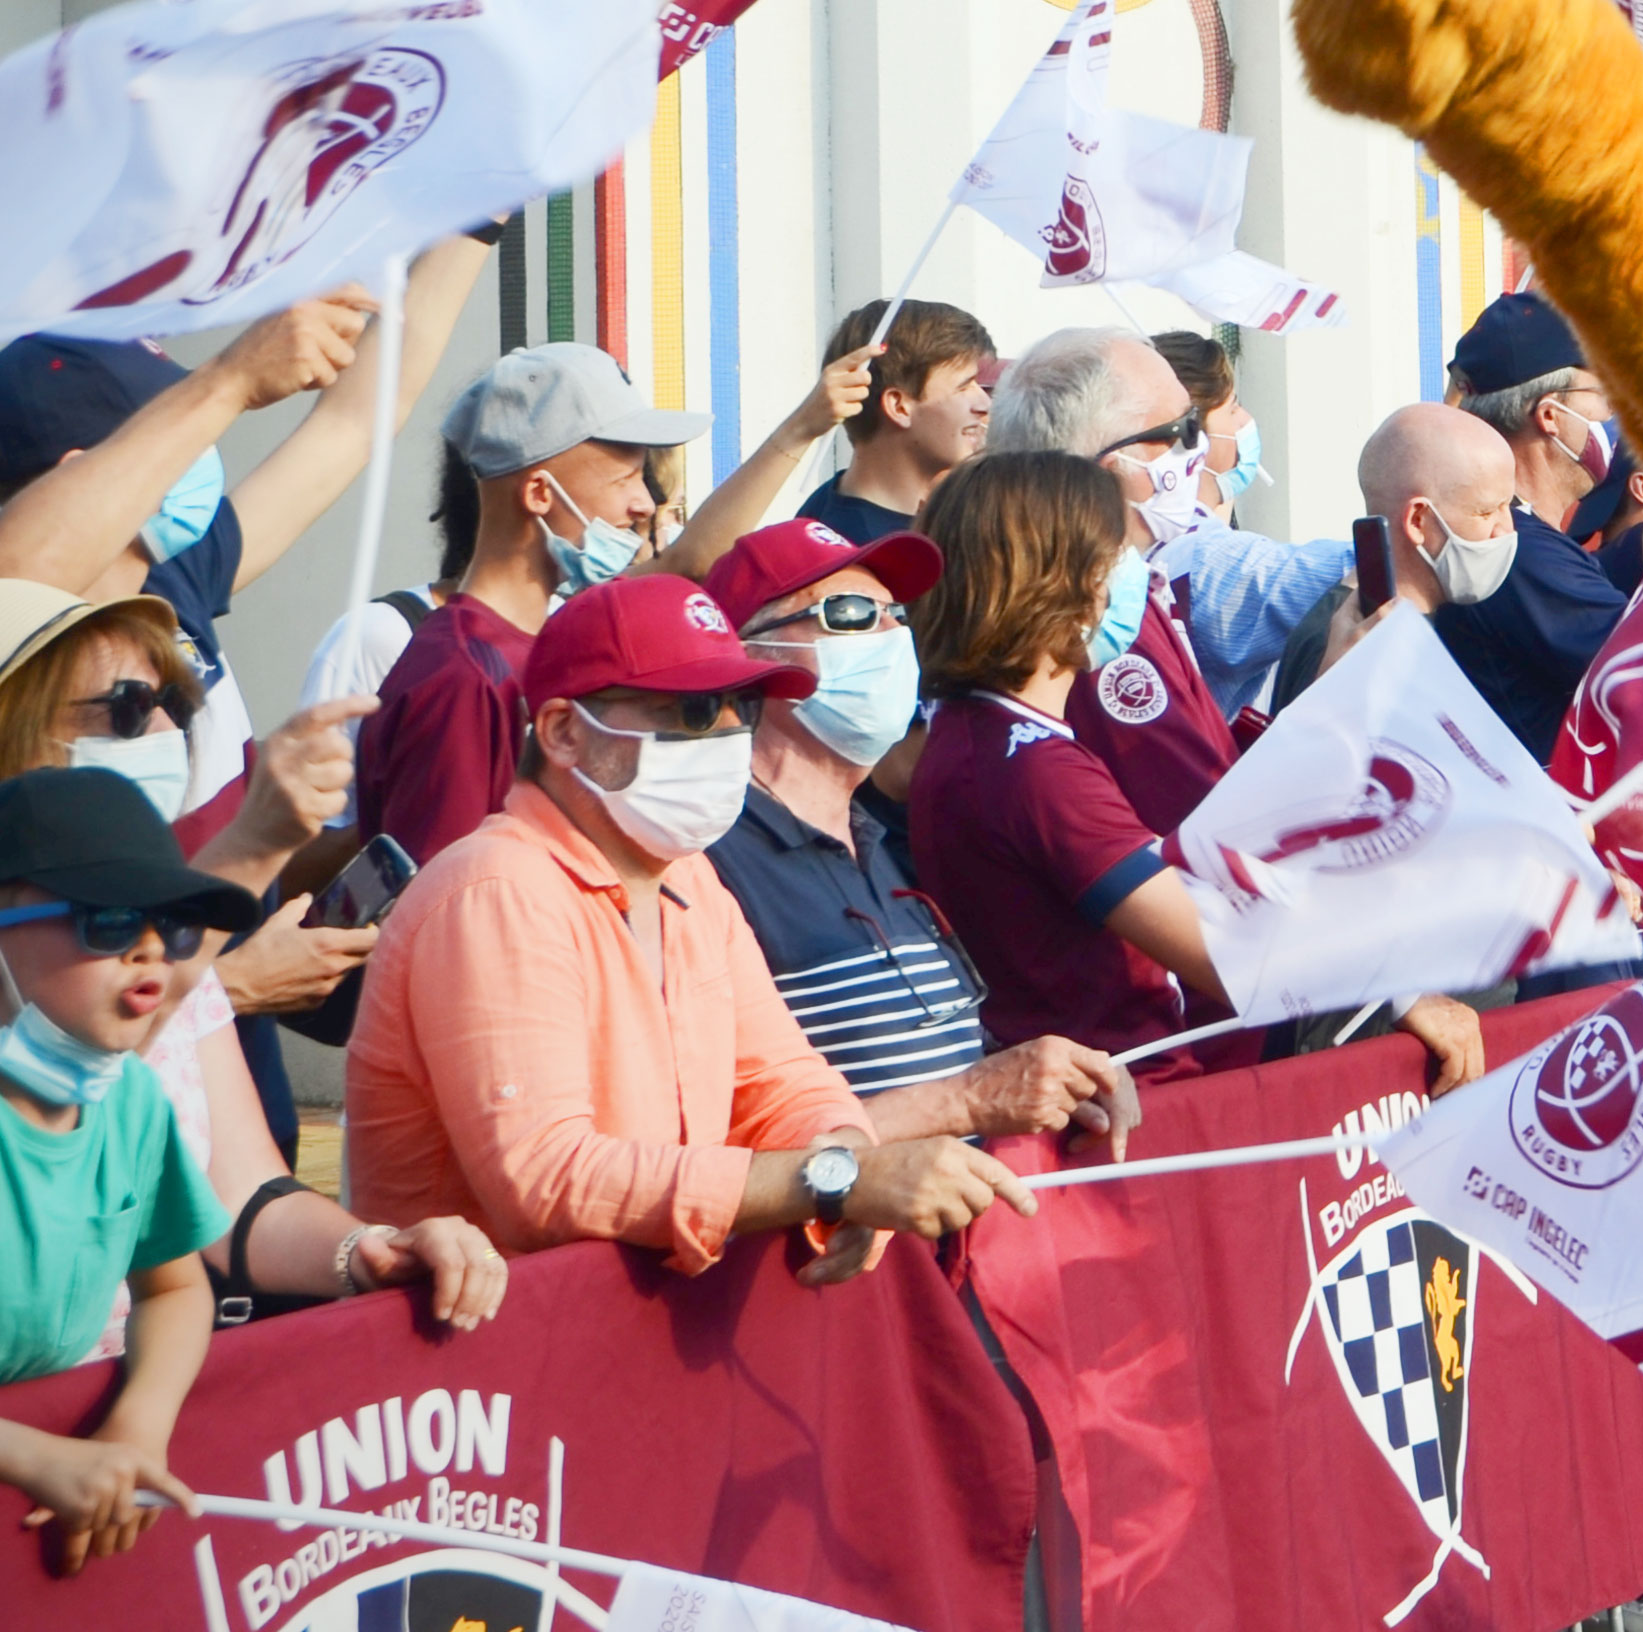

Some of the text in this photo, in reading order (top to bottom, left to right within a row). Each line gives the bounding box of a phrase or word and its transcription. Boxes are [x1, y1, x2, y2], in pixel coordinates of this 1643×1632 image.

[1521, 1123, 1583, 1176] RUGBY
[1490, 1182, 1528, 1221] CAP
[1528, 1204, 1589, 1272] INGELEC
[262, 1386, 513, 1532] UNION
[428, 1475, 541, 1542] BEGLES
